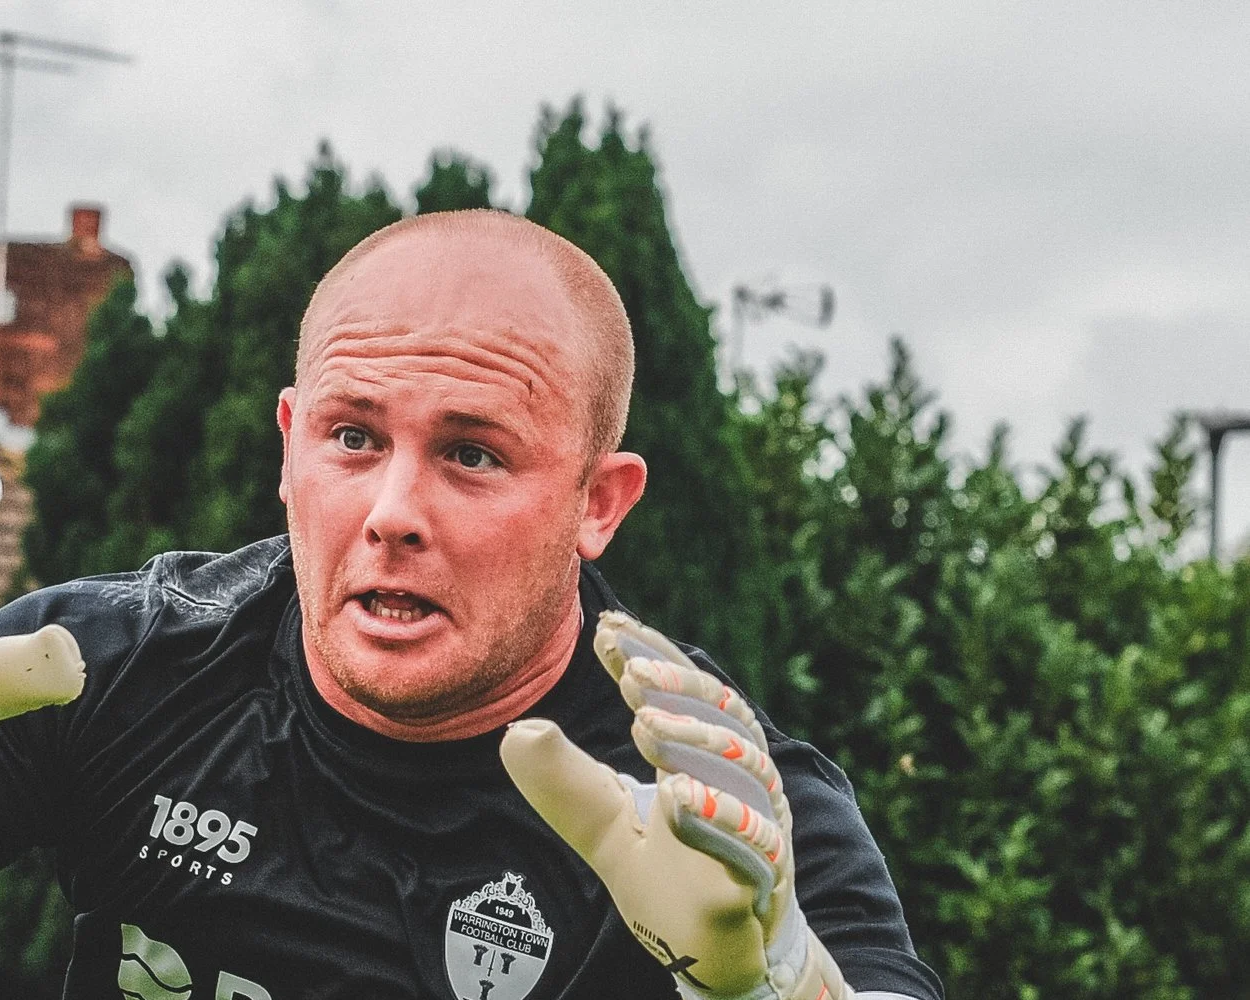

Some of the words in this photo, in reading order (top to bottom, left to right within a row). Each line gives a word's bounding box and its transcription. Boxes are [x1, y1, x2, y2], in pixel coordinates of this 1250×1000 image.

[150, 794, 258, 863] 1895
[139, 845, 233, 885] SPORTS
[453, 911, 518, 939] WARRINGTON
[520, 930, 549, 948] TOWN
[495, 905, 515, 919] 1949
[461, 924, 504, 946] FOOTBALL
[506, 939, 532, 954] CLUB
